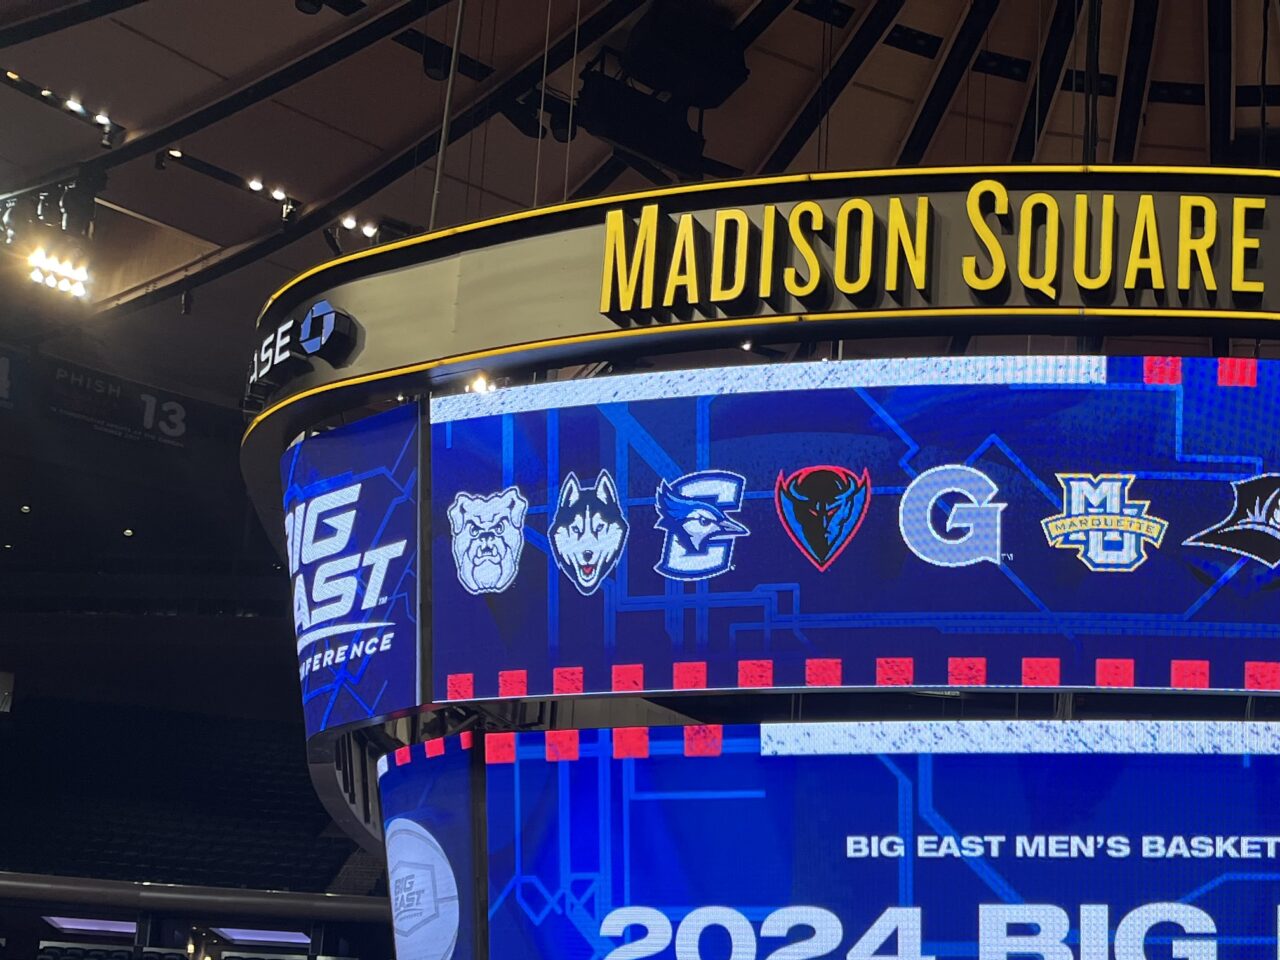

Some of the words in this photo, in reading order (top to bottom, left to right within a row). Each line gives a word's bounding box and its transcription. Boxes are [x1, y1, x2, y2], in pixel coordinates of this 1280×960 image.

[600, 195, 928, 314] MADISON
[962, 178, 1266, 300] SQUARE
[56, 368, 121, 399] PHISH
[140, 393, 187, 438] 13
[1053, 514, 1157, 536] MARQUETTE
[293, 539, 407, 637] AST
[299, 632, 395, 681] FERENCE
[846, 836, 905, 858] BIG
[917, 835, 1006, 858] EAST
[1016, 835, 1131, 858] MEN'S
